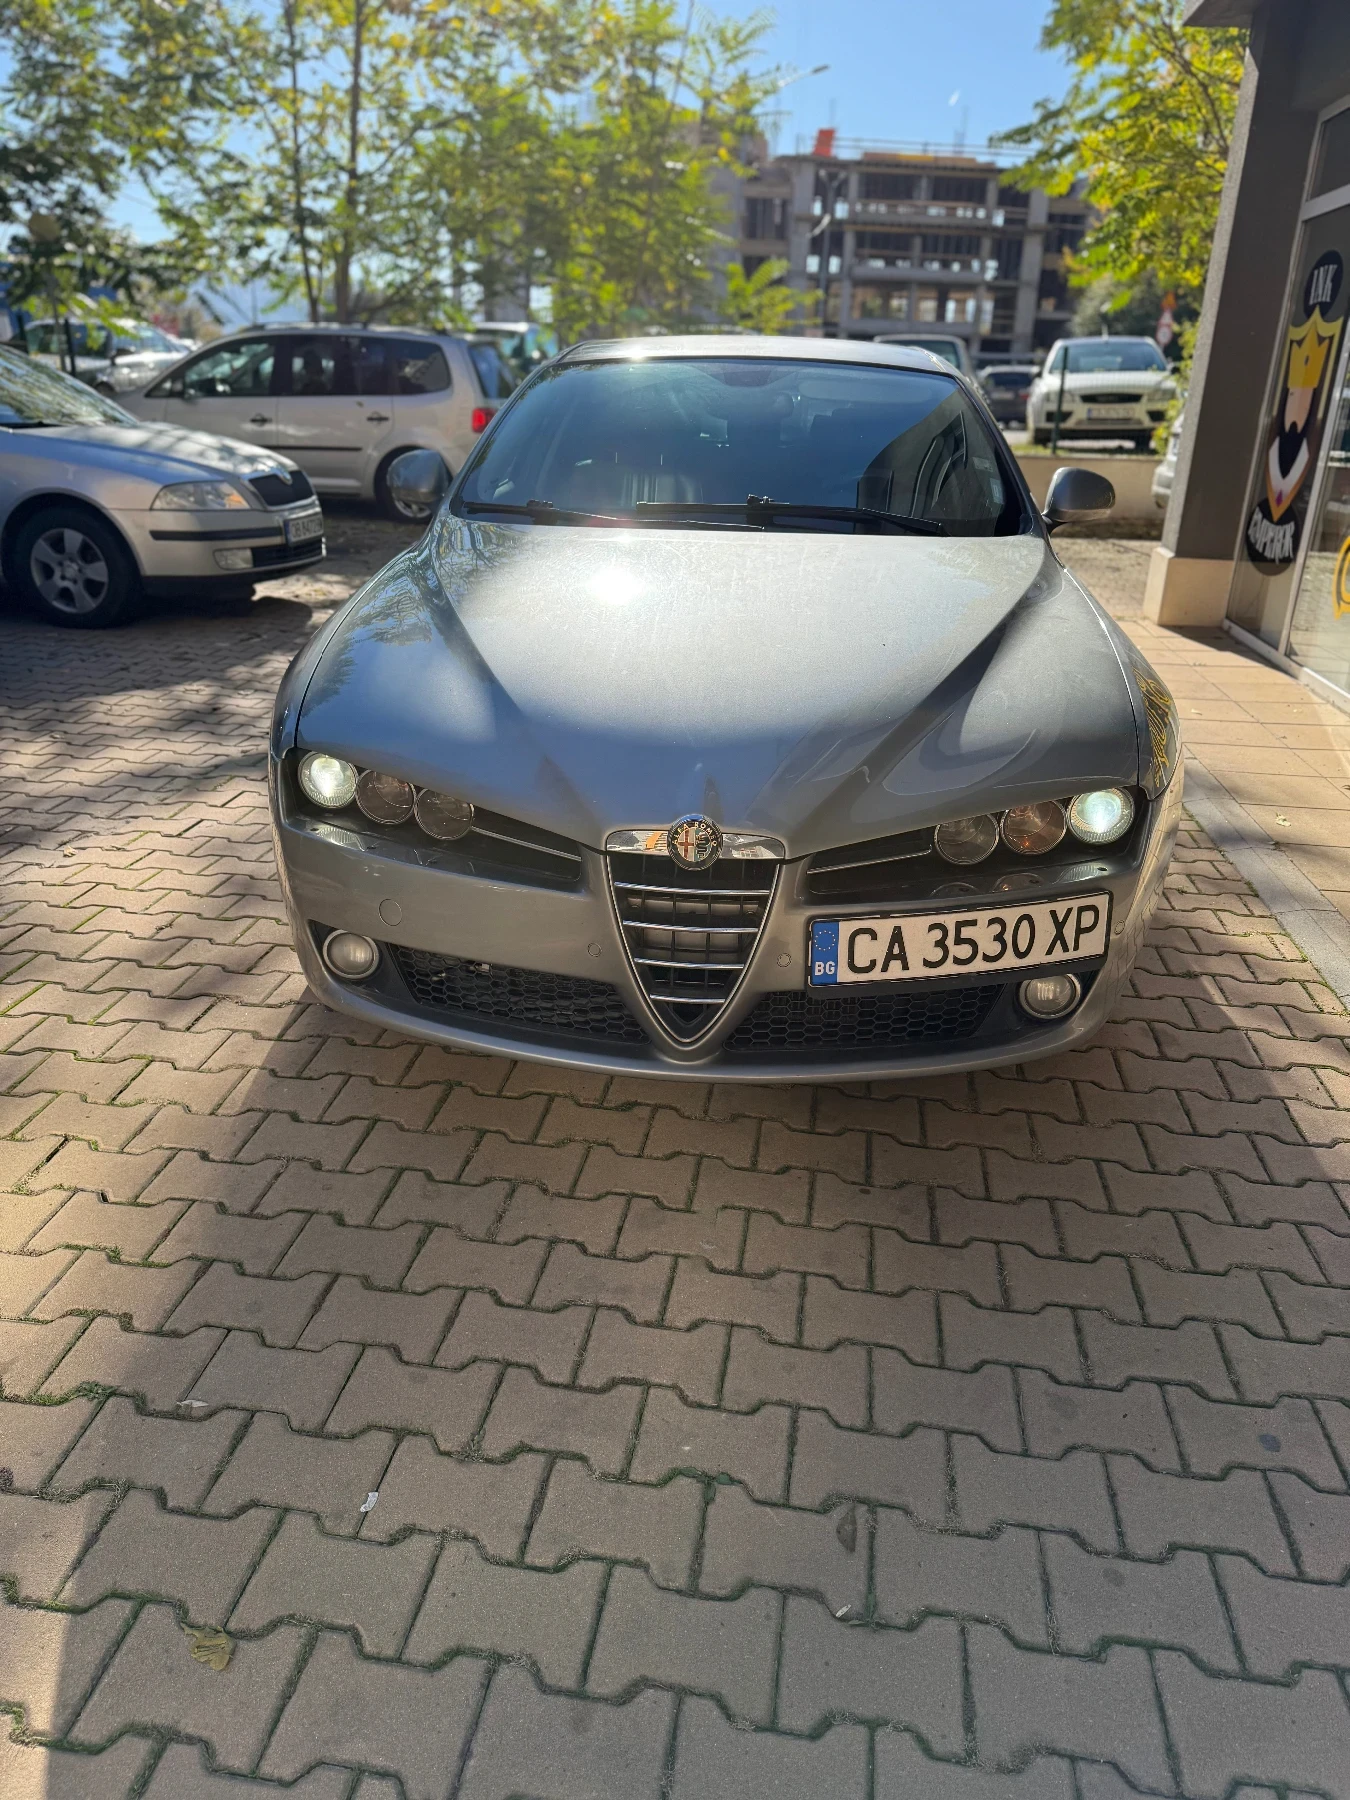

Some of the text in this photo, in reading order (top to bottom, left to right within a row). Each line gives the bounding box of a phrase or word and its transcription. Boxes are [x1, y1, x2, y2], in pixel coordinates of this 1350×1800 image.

[1309, 264, 1338, 305] INK
[694, 821, 717, 847] ROMEO
[847, 904, 1100, 973] CA 3530 XP
[814, 960, 836, 976] BG
